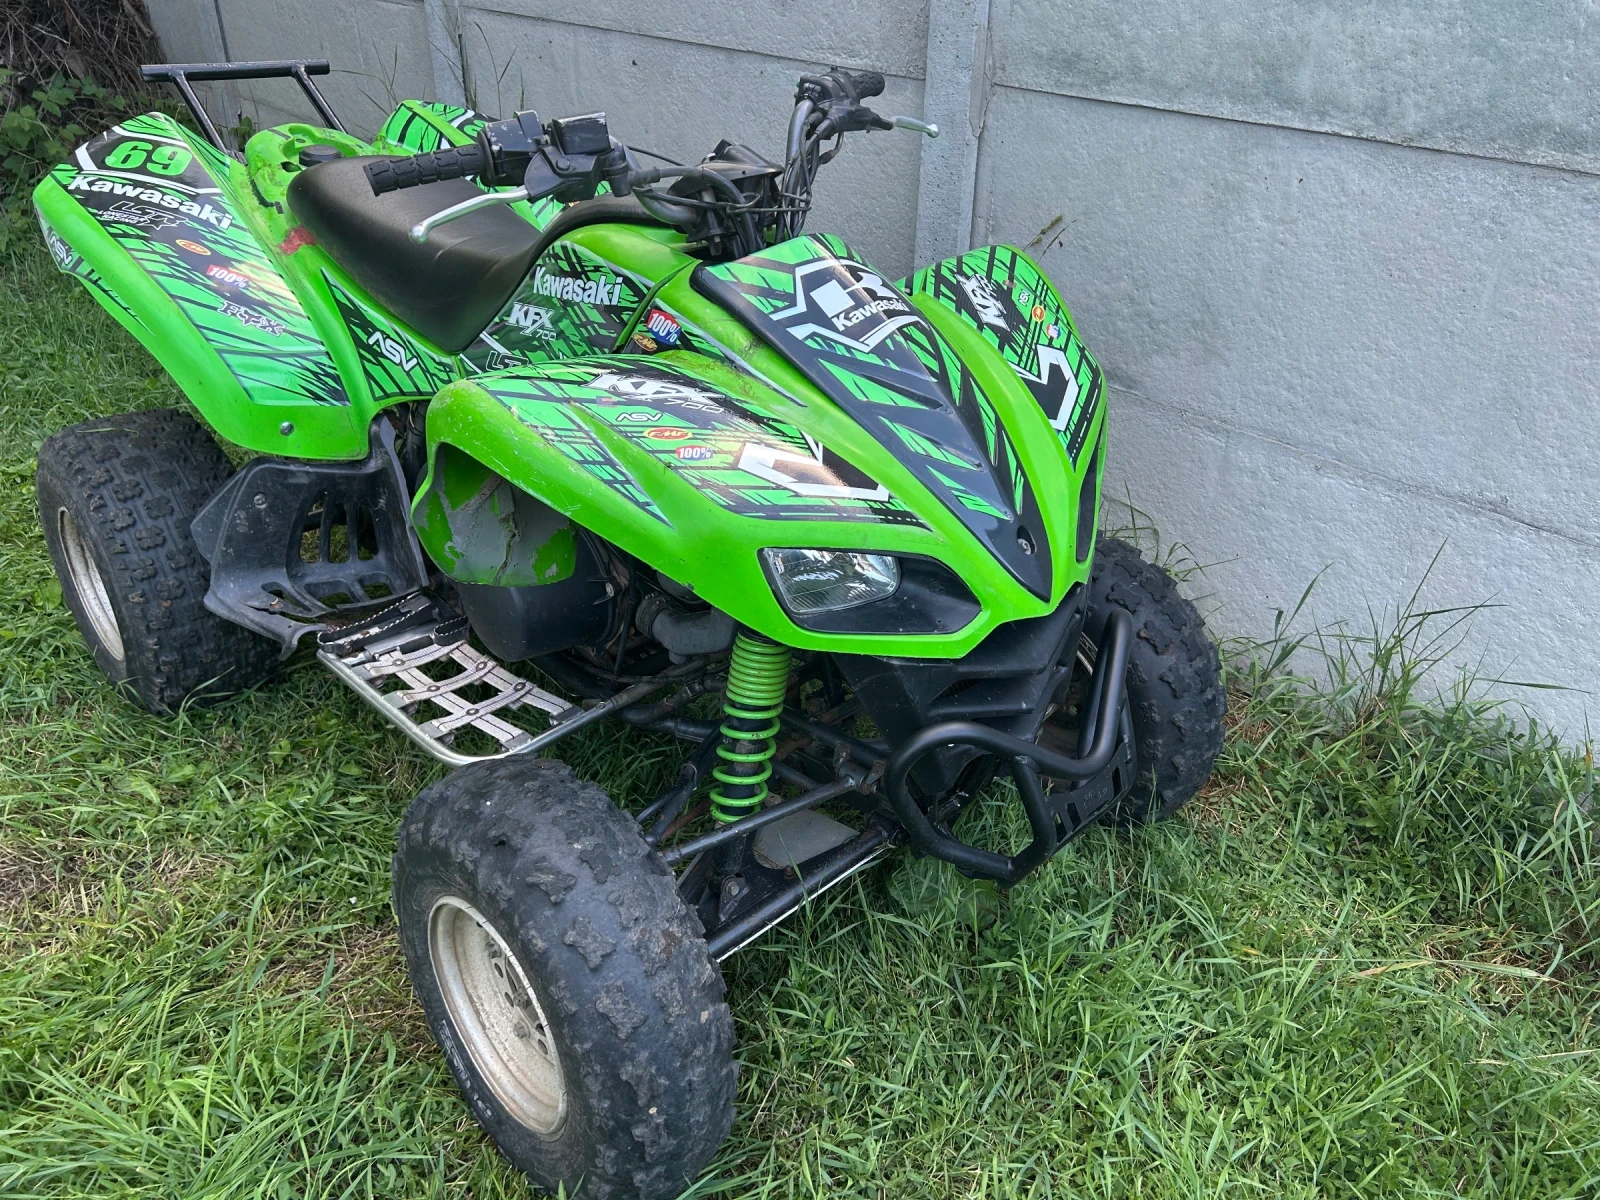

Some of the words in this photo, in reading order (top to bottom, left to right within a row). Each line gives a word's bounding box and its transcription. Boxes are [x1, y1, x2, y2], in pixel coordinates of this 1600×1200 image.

[105, 141, 192, 176] 69
[68, 176, 233, 230] Kawasaki
[208, 267, 249, 288] 100%
[533, 266, 623, 305] Kawasaki
[505, 302, 555, 336] KFX
[648, 313, 681, 342] 100%
[831, 298, 910, 332] Kawasaki
[535, 329, 557, 341] 700
[616, 412, 662, 422] ASV
[664, 398, 724, 413] 700
[647, 429, 690, 438] FMF
[678, 447, 711, 459] 100%
